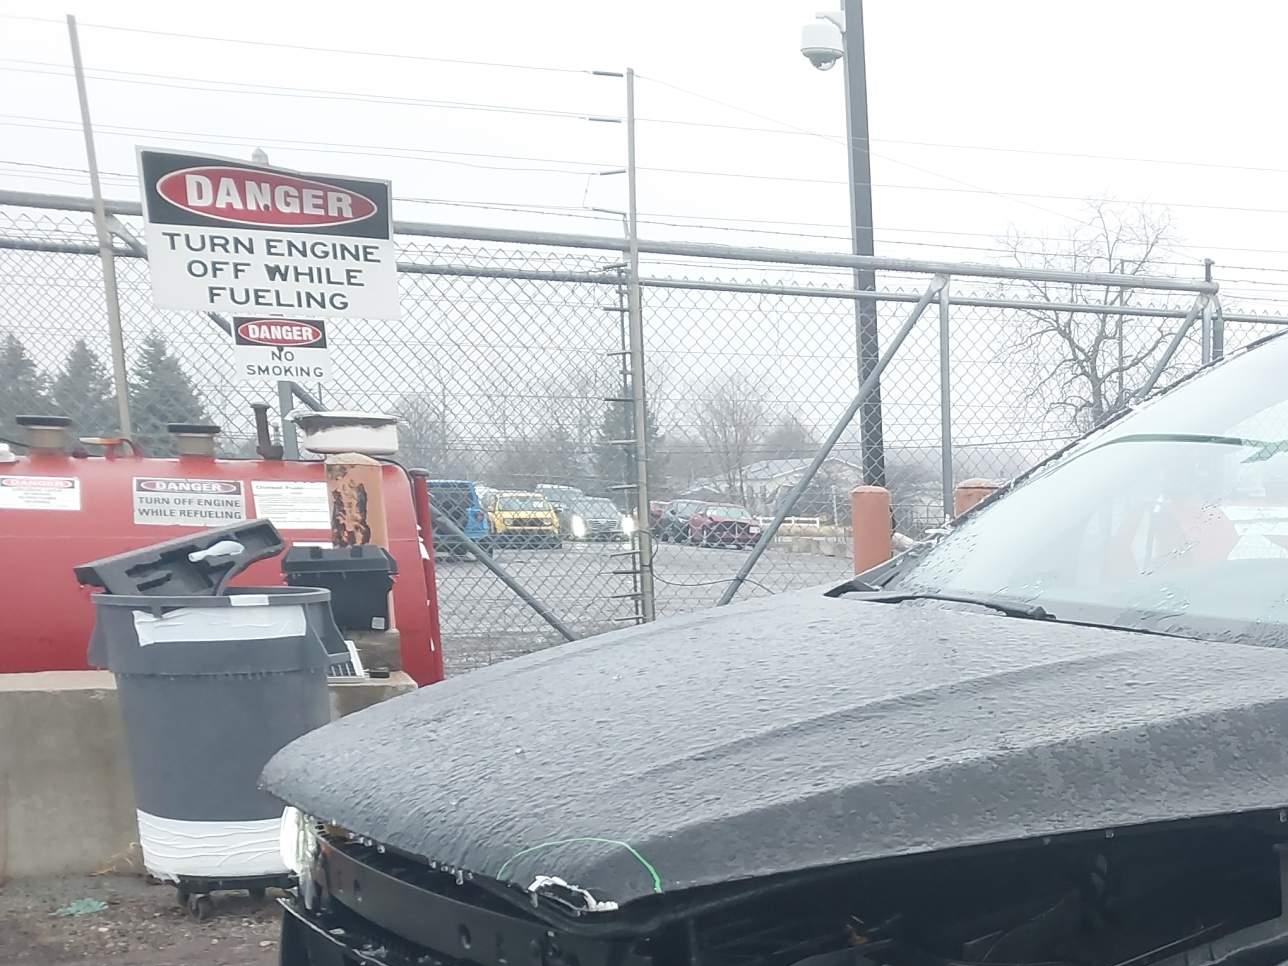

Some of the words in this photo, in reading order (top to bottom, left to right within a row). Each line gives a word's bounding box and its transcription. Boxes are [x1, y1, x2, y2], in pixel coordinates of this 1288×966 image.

[185, 174, 354, 218] DANGER
[162, 232, 255, 255] TURN
[265, 238, 381, 263] ENGINE
[187, 259, 251, 279] OFF
[264, 264, 365, 287] WHILE
[208, 287, 349, 310] FUELING
[247, 324, 313, 341] DANGER
[271, 350, 295, 361] NO
[246, 364, 324, 378] SMOKING
[155, 480, 222, 492] DANGER
[137, 496, 171, 505] TURN
[173, 497, 193, 506] OFF
[197, 498, 241, 508] ENGINE
[137, 508, 177, 518] WHILE
[179, 509, 242, 520] REFUELING
